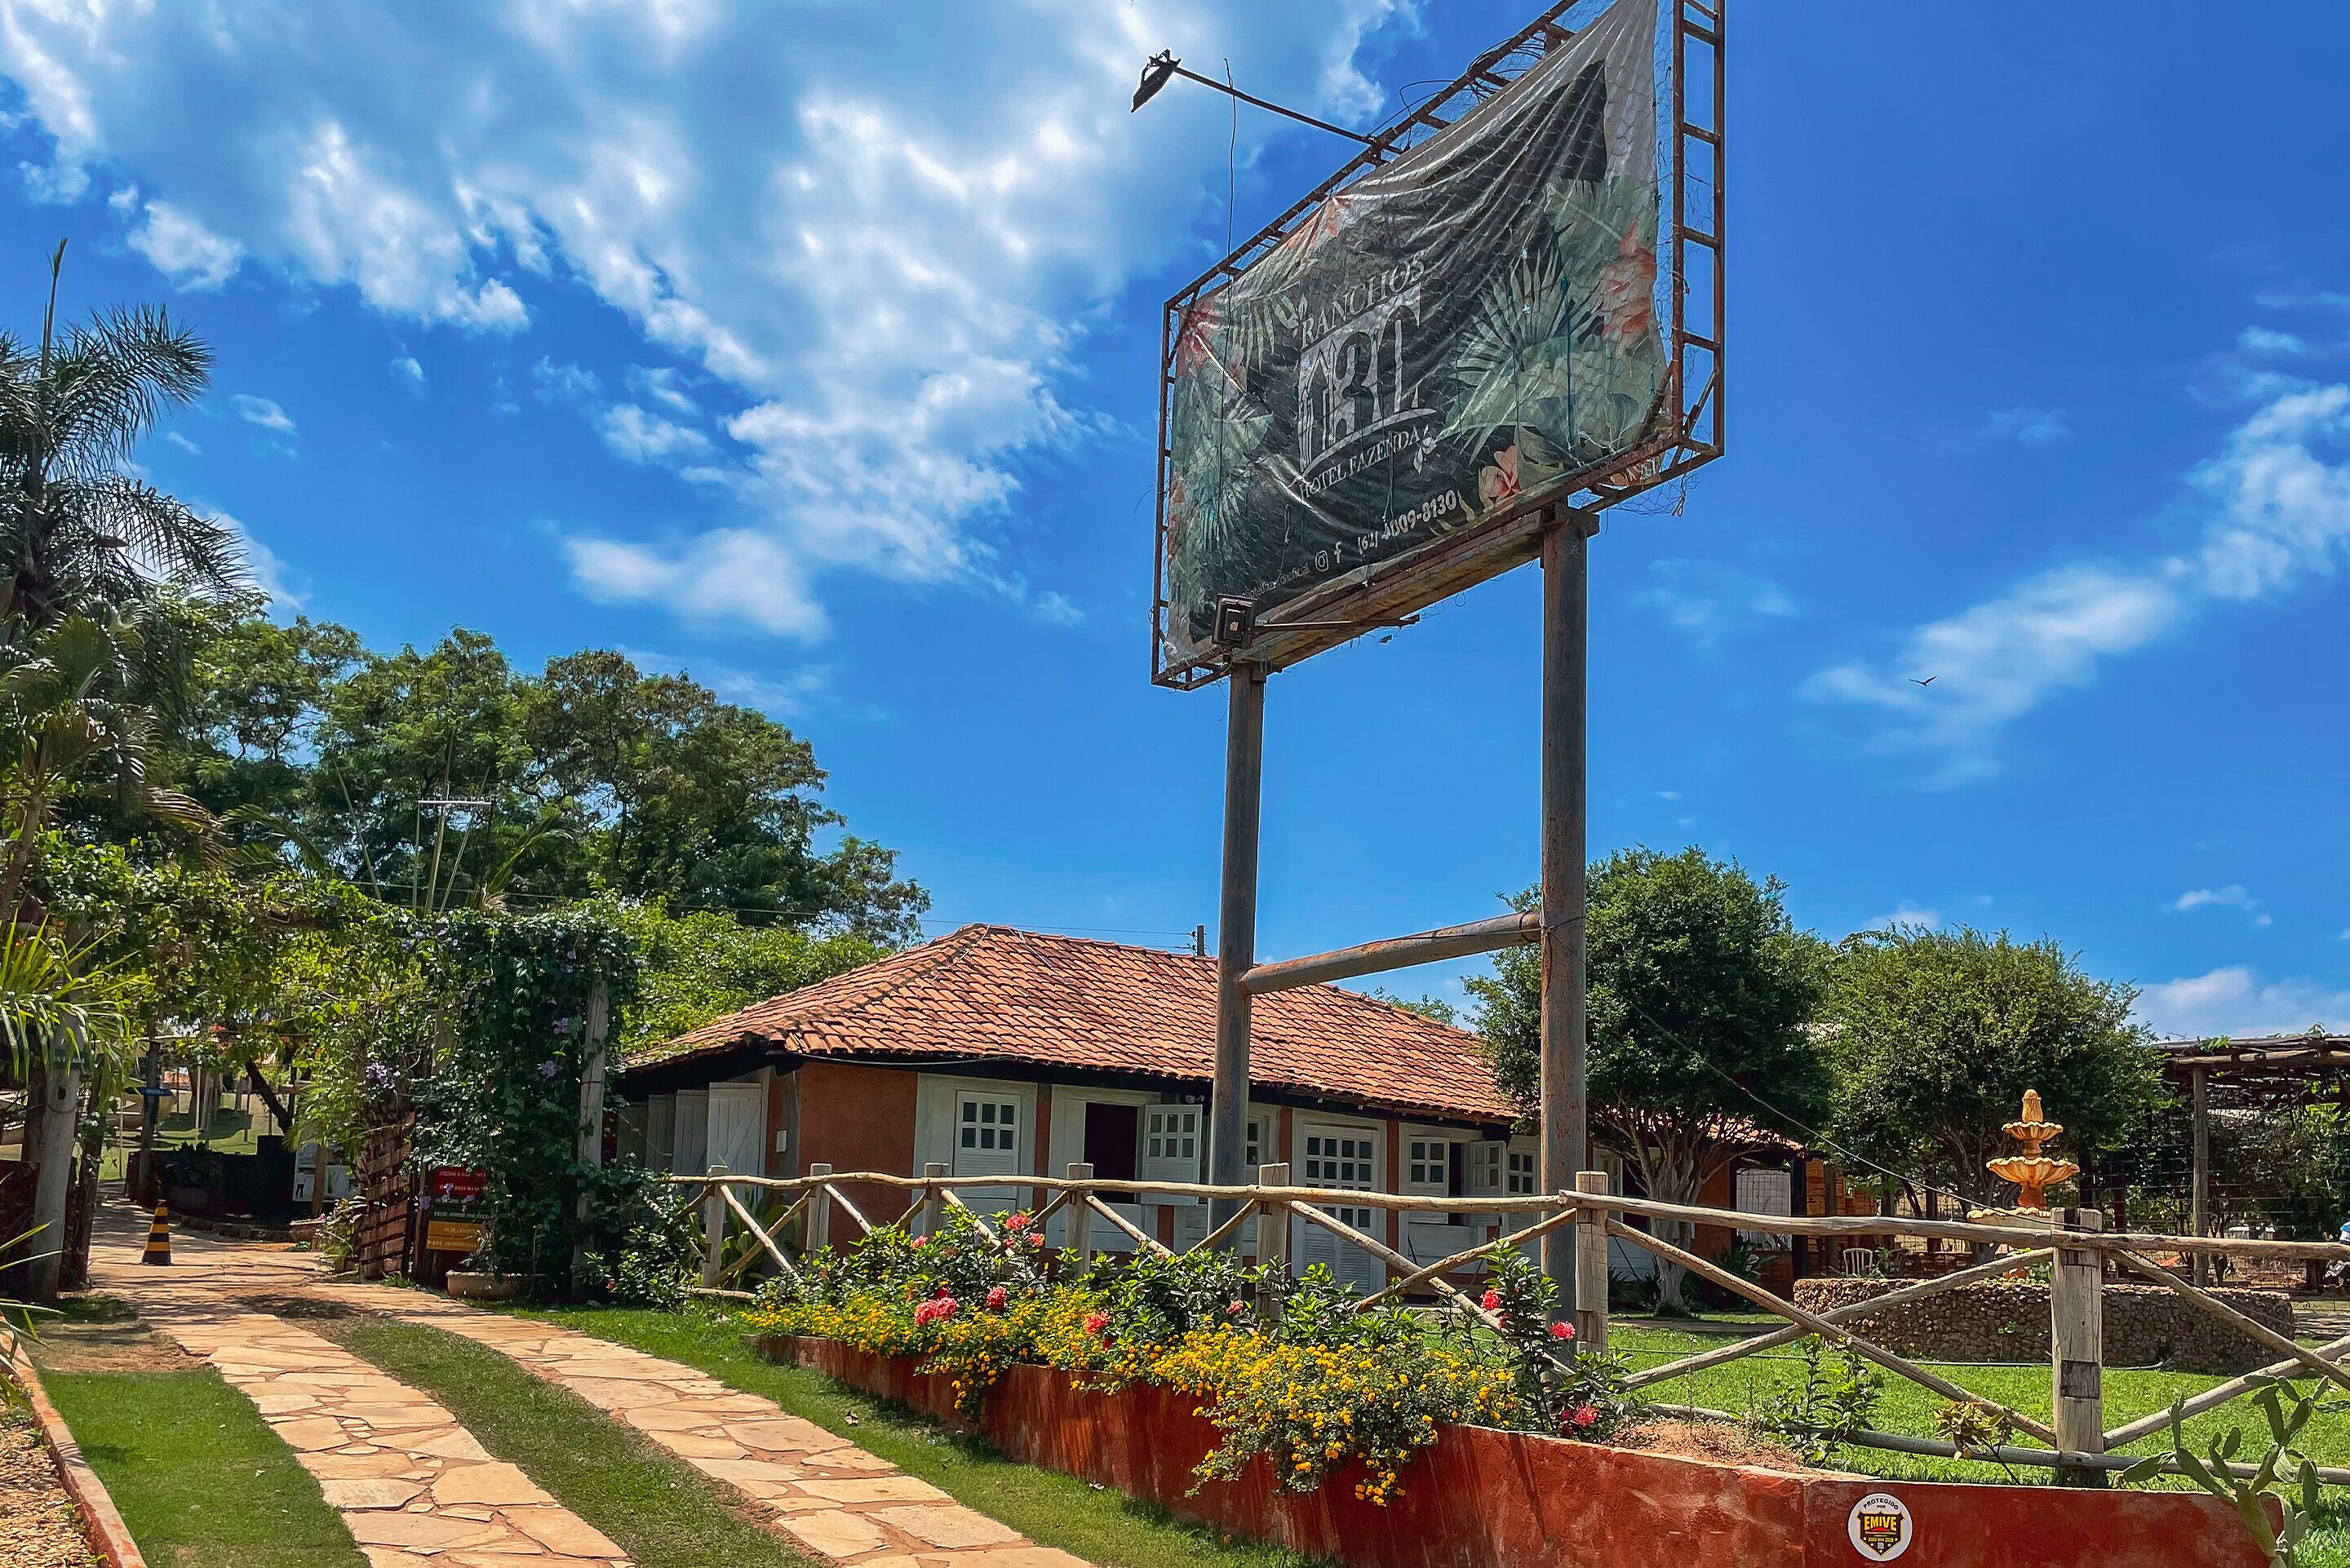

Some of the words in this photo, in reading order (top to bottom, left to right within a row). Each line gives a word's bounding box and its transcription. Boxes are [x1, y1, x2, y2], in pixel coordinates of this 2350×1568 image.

[1301, 250, 1424, 352] RANCHOS
[1299, 463, 1346, 498] HOTEL
[1348, 424, 1420, 476] FAZENDA
[1863, 1498, 1899, 1509] PROTEGIDO
[1864, 1516, 1897, 1531] EMIVE
